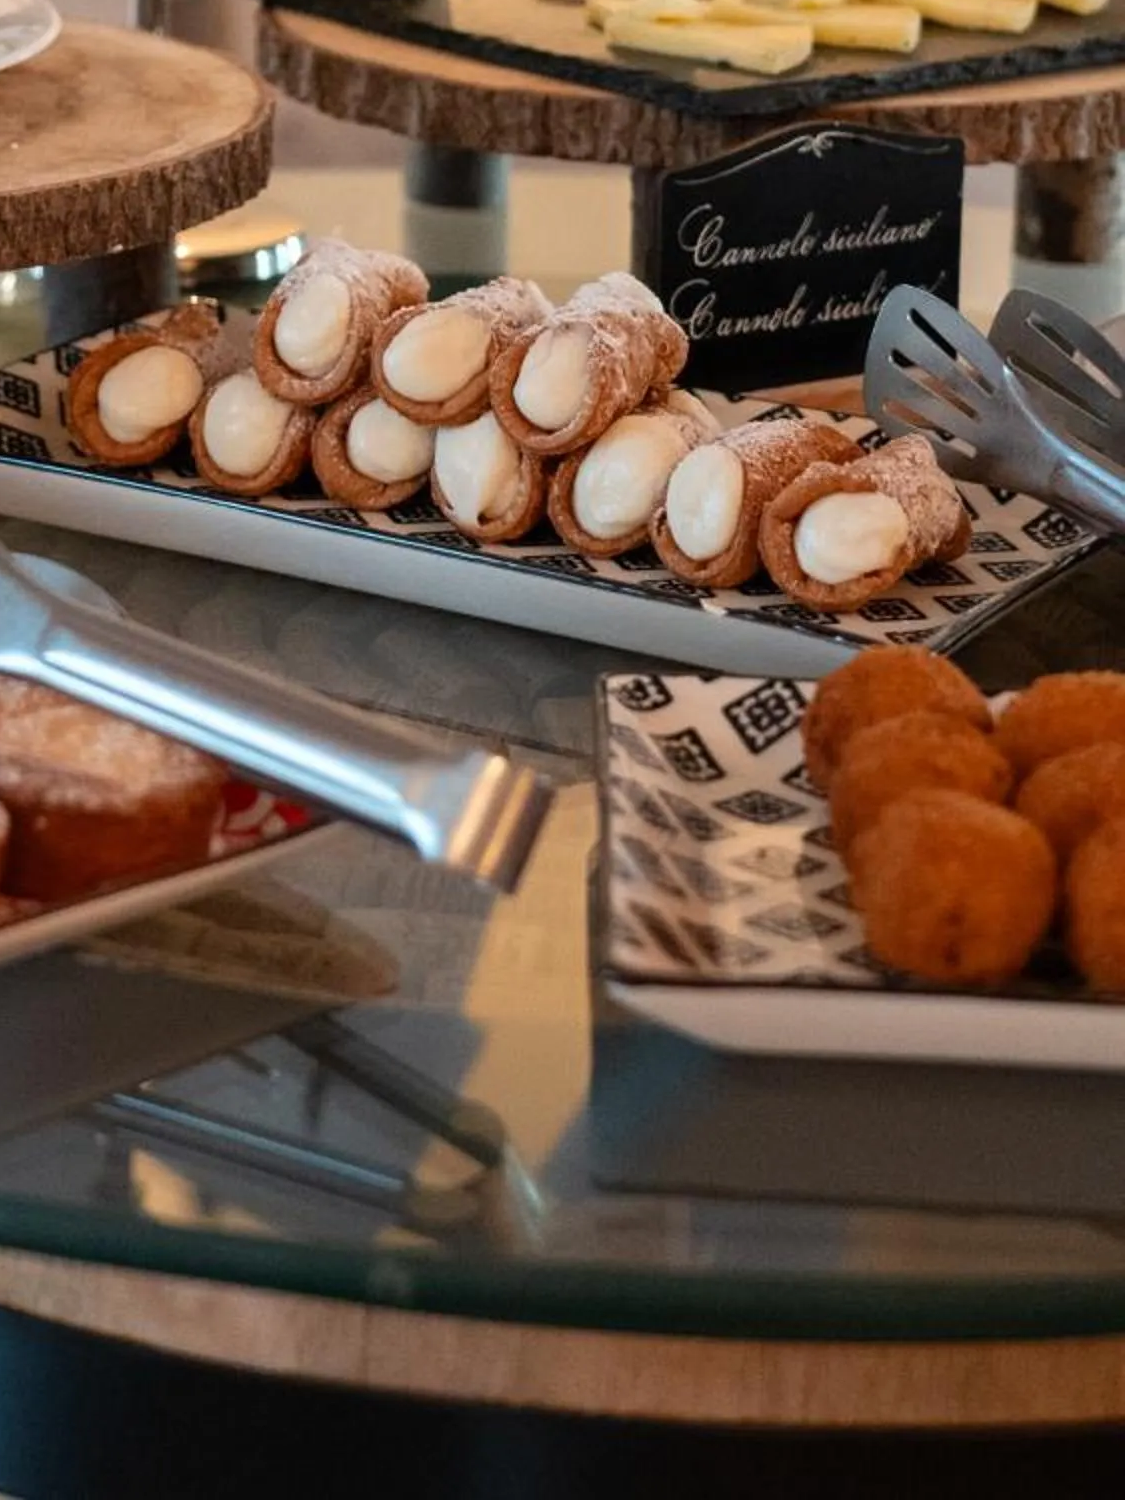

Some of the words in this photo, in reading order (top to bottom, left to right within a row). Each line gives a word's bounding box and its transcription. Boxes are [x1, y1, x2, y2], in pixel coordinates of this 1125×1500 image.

[677, 203, 819, 268] Cannolo
[818, 204, 942, 255] siciliano
[669, 277, 808, 340] Cannolo
